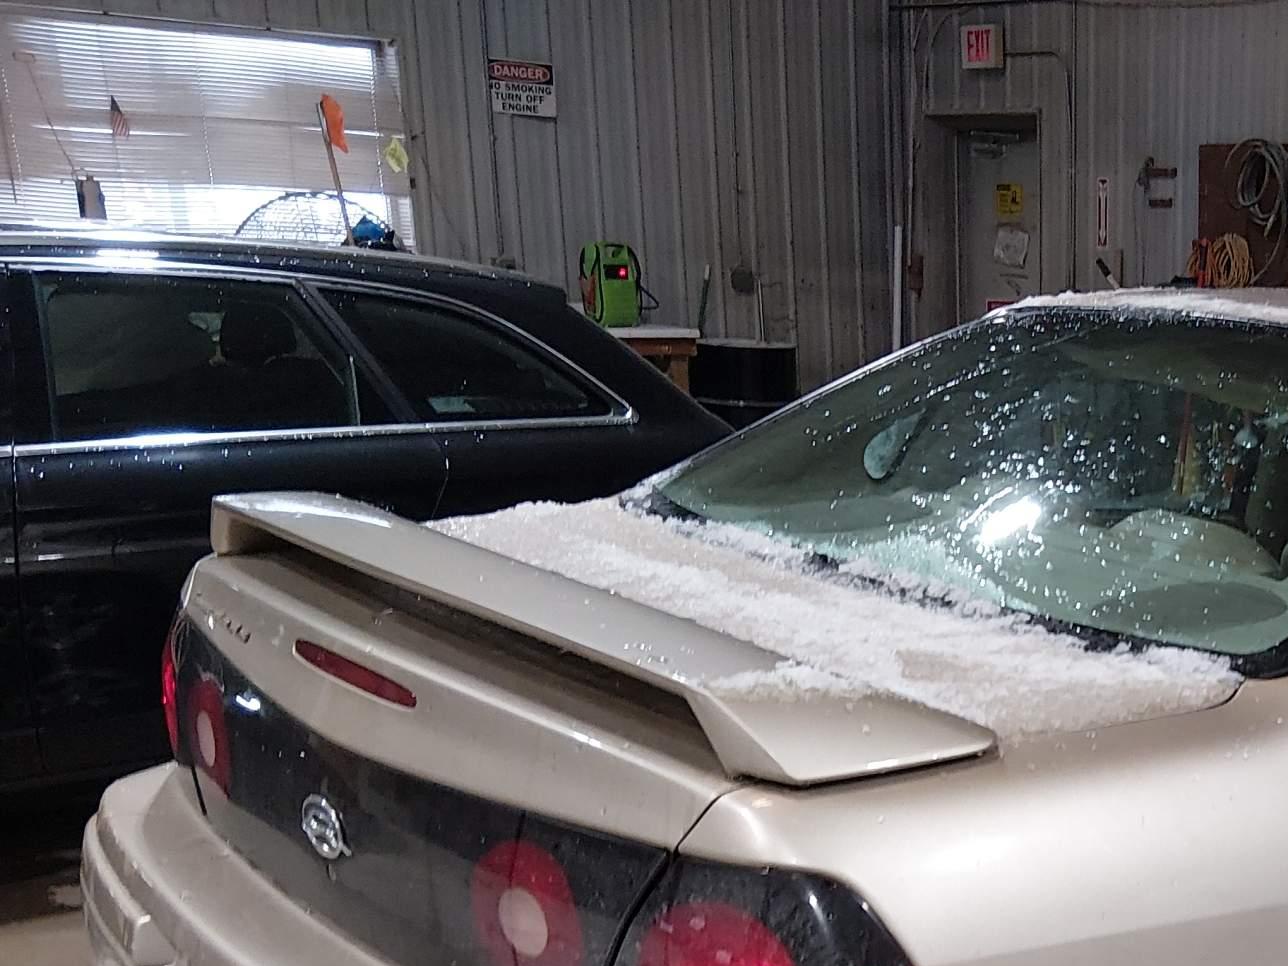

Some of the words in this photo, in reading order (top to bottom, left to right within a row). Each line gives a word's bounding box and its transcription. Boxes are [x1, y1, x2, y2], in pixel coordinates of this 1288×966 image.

[967, 29, 992, 62] EXIT
[494, 65, 543, 80] DANGER
[506, 84, 552, 95] SMOKING
[495, 92, 522, 101] TURN
[526, 95, 545, 104] OFF
[502, 102, 539, 113] ENGINE
